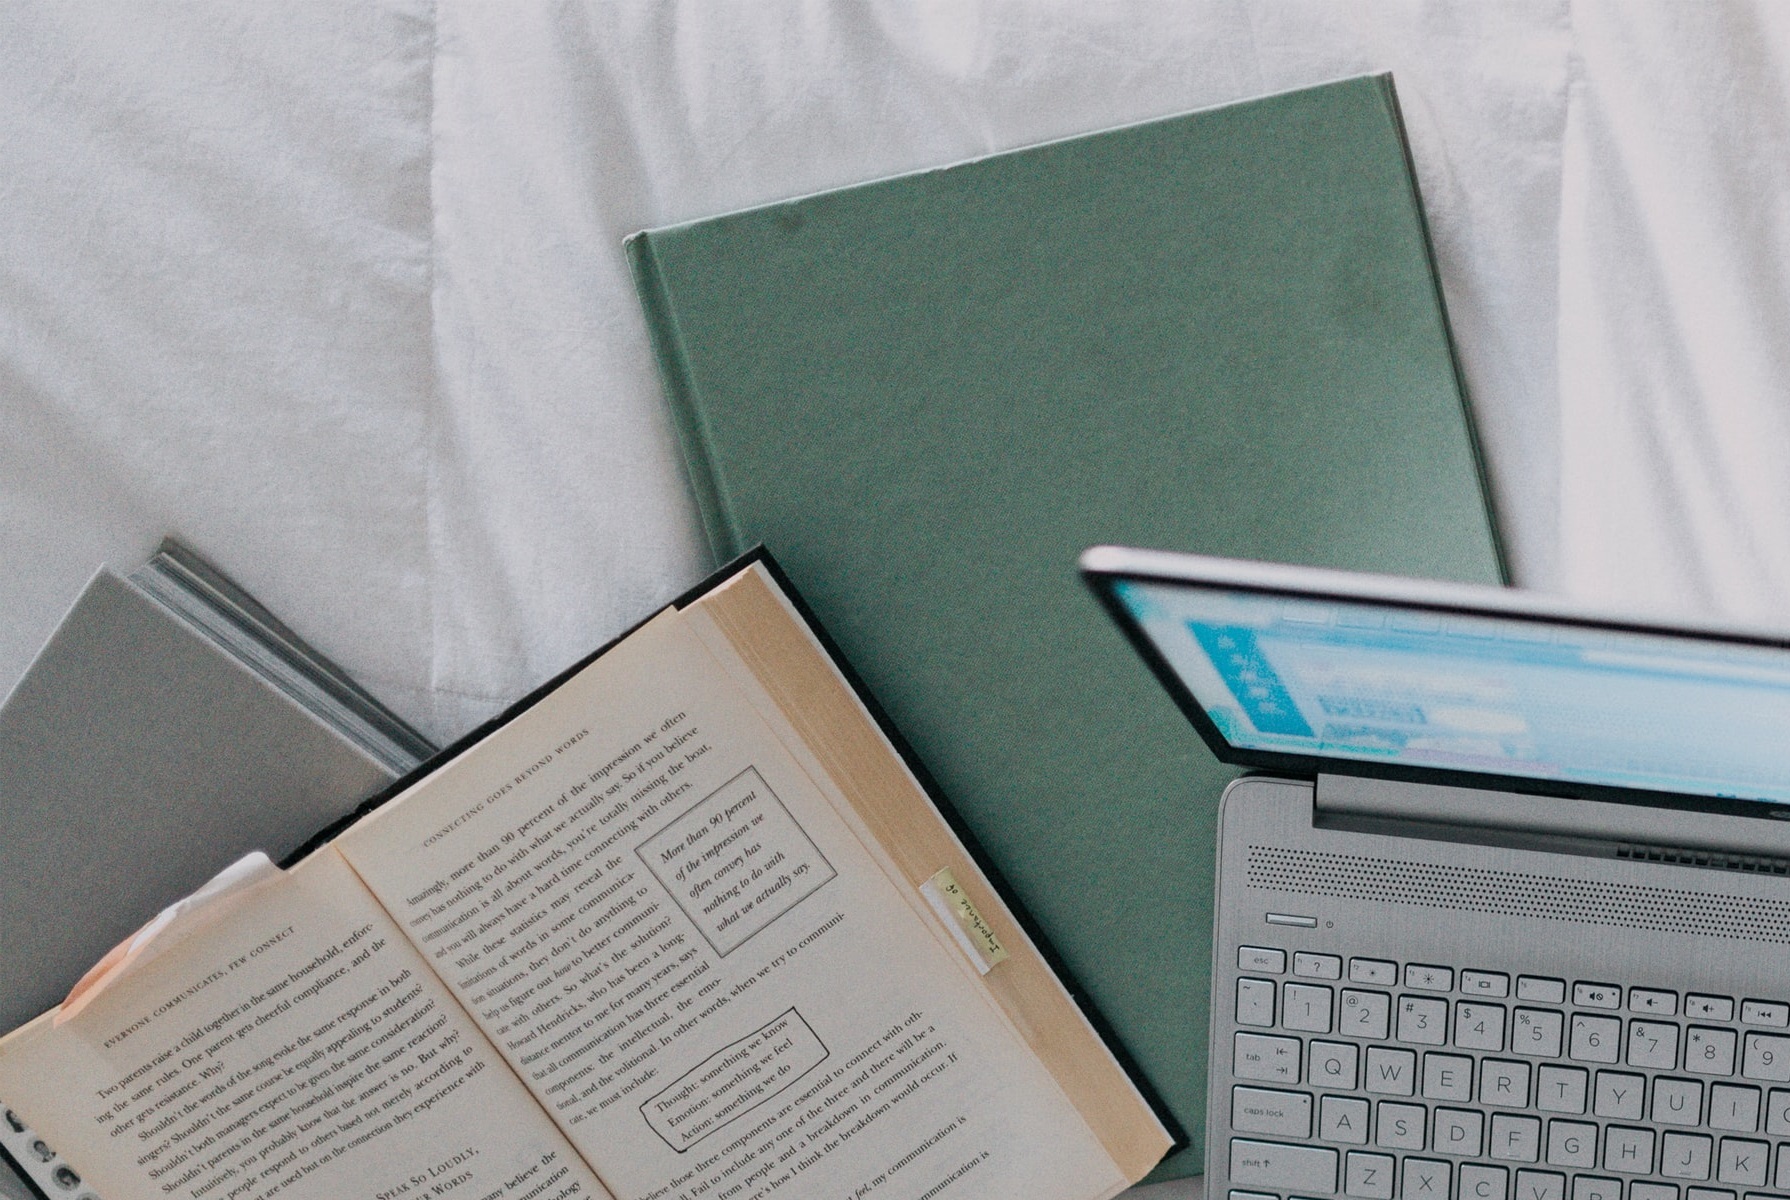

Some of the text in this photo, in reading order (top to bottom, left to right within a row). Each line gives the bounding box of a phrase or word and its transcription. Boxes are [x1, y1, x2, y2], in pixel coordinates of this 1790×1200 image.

[422, 727, 590, 848] CONNECTING GOES BEYOND WORDS
[659, 789, 757, 864] More than 90 percent
[674, 812, 765, 882] of the impression we
[945, 884, 1000, 953] Importance of
[1253, 957, 1269, 965] esc
[103, 924, 295, 1049] EVERYONE COMMUNICATES, FEW CONNECT
[1473, 1020, 1485, 1035] 4
[655, 1012, 789, 1113] Thought: something we know
[1245, 1053, 1261, 1062] tab
[1324, 1057, 1342, 1076] Q
[666, 1036, 794, 1128] Emotion: something we feel
[1379, 1064, 1402, 1082] W
[1440, 1069, 1454, 1088] E
[1496, 1075, 1512, 1093] R
[1555, 1081, 1569, 1099] T
[1612, 1088, 1627, 1105] Y
[1669, 1094, 1685, 1112] U
[1243, 1107, 1284, 1118] caps lock
[1336, 1113, 1352, 1130] A
[1394, 1119, 1408, 1137] S
[1449, 1124, 1466, 1142] D
[1563, 1136, 1580, 1155] G
[1621, 1143, 1637, 1160] H
[1241, 1159, 1261, 1168] shift
